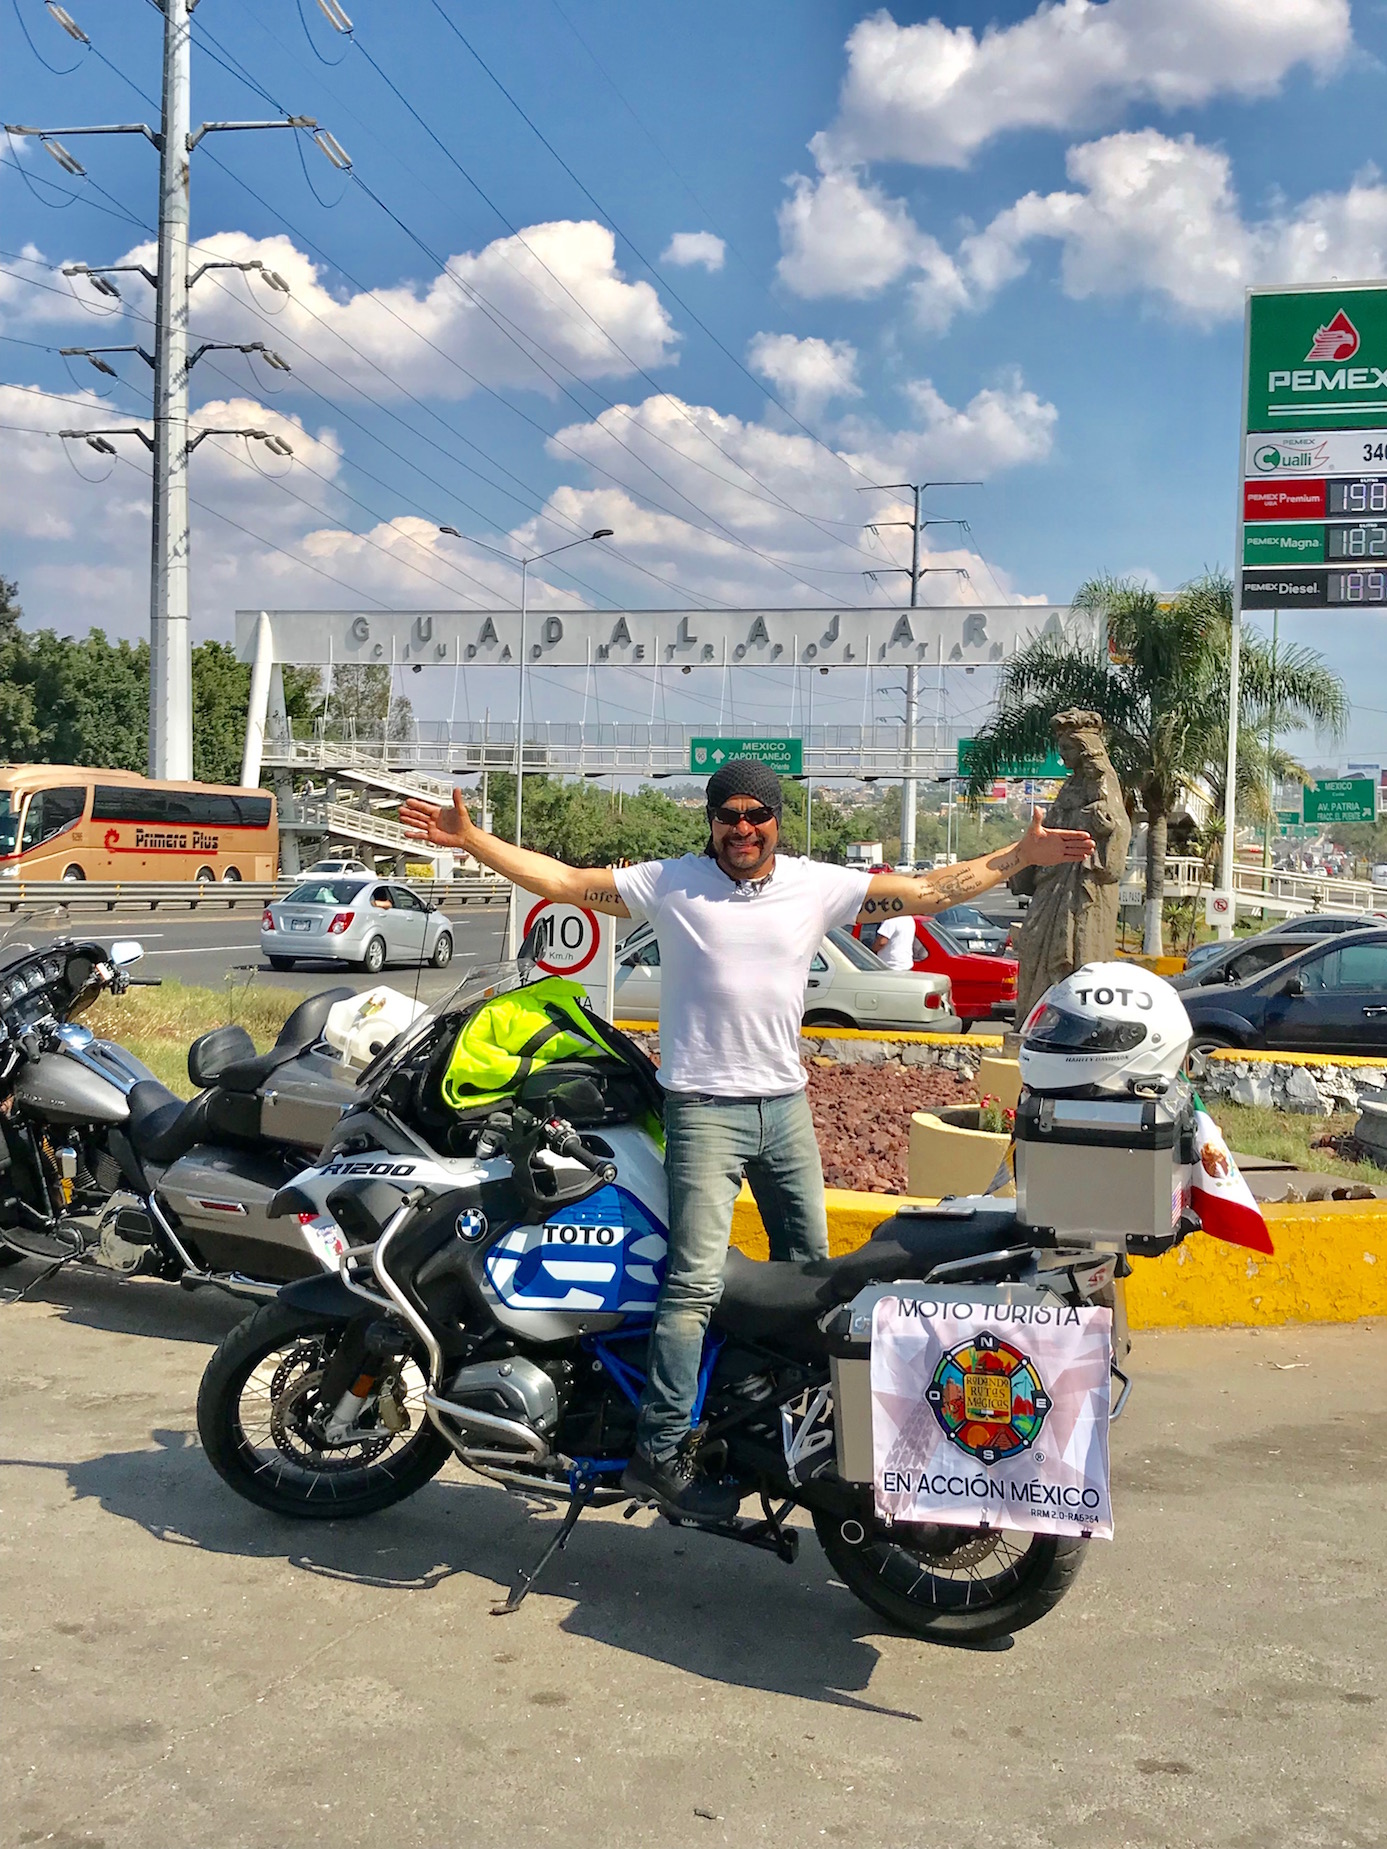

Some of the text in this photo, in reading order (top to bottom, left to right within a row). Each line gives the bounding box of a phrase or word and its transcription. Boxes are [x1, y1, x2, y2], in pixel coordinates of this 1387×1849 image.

[1268, 368, 1387, 393] PEMEX
[1363, 443, 1387, 462] 34
[1247, 493, 1320, 503] PEMEX Premium
[1247, 537, 1320, 550] PEMEX Magna
[1244, 581, 1318, 594] PEMEX Diesel
[352, 612, 1066, 643] GUADALAJARA
[373, 641, 1004, 661] CIUDAD METROPOLITAN
[742, 742, 786, 751] MEXICO
[728, 752, 791, 761] ZAPOTLANEJO
[1324, 782, 1353, 790] MEXICO
[1331, 802, 1360, 811] PATRIA
[135, 828, 187, 848] Primera
[192, 831, 219, 849] Plus
[1129, 891, 1141, 902] PASO
[859, 896, 904, 916] oto
[545, 914, 584, 949] 10
[1075, 987, 1153, 1010] TOTO
[319, 1162, 417, 1177] R1200
[458, 1208, 484, 1222] BMW
[542, 1224, 615, 1246] TOTO
[897, 1300, 1081, 1327] MOTO TURISTA
[980, 1337, 993, 1347] N
[1035, 1398, 1047, 1409] E
[982, 1449, 995, 1460] S
[883, 1472, 1100, 1508] EN ACCIÓN MÉXICO
[1030, 1508, 1050, 1519] RRM
